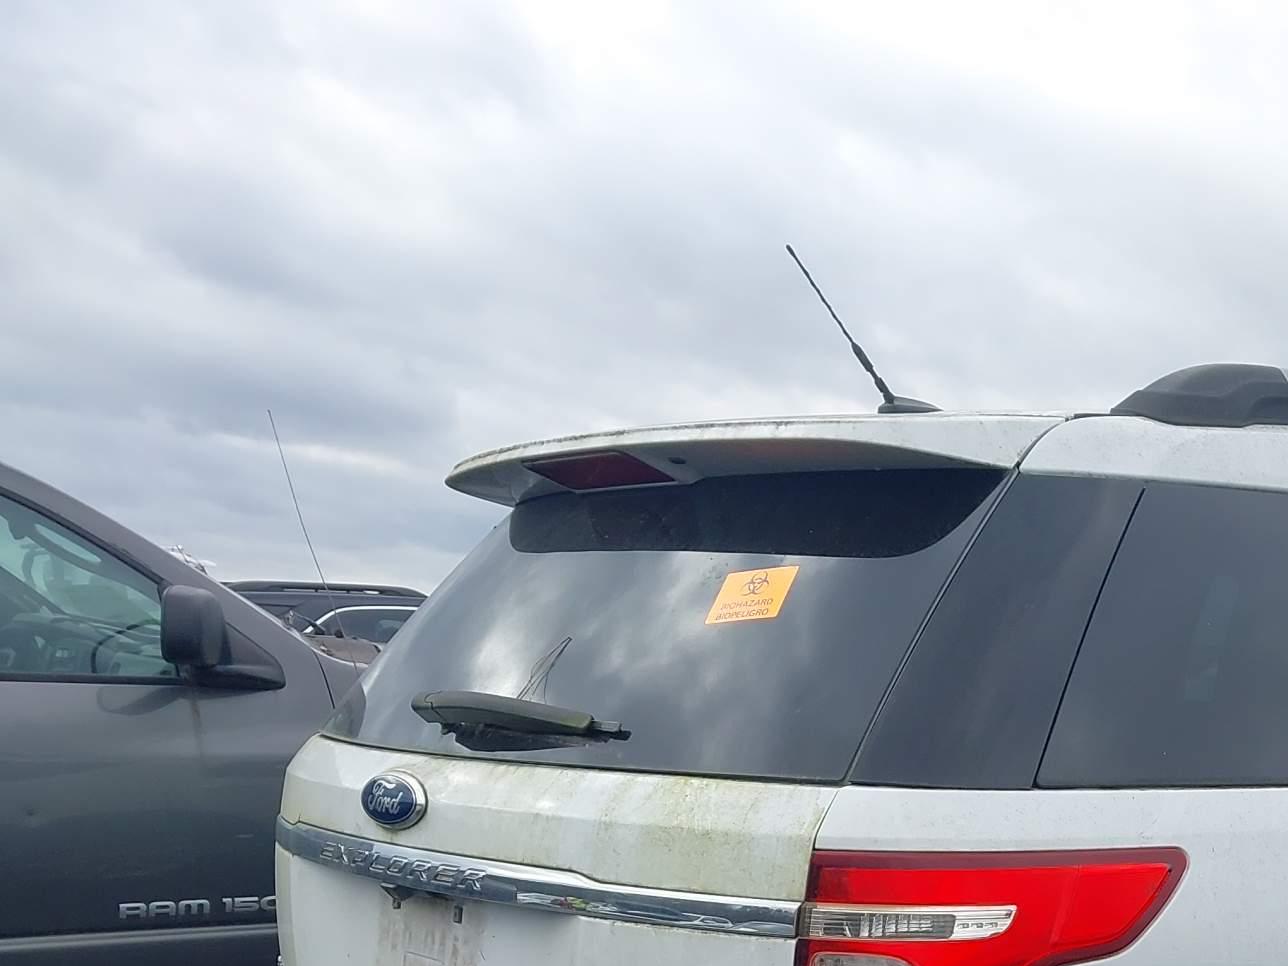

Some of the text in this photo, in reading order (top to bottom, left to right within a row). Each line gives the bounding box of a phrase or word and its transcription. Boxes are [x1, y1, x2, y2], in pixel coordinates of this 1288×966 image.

[367, 779, 404, 815] Ford
[319, 841, 488, 891] EXPLORER
[118, 899, 210, 920] RAM
